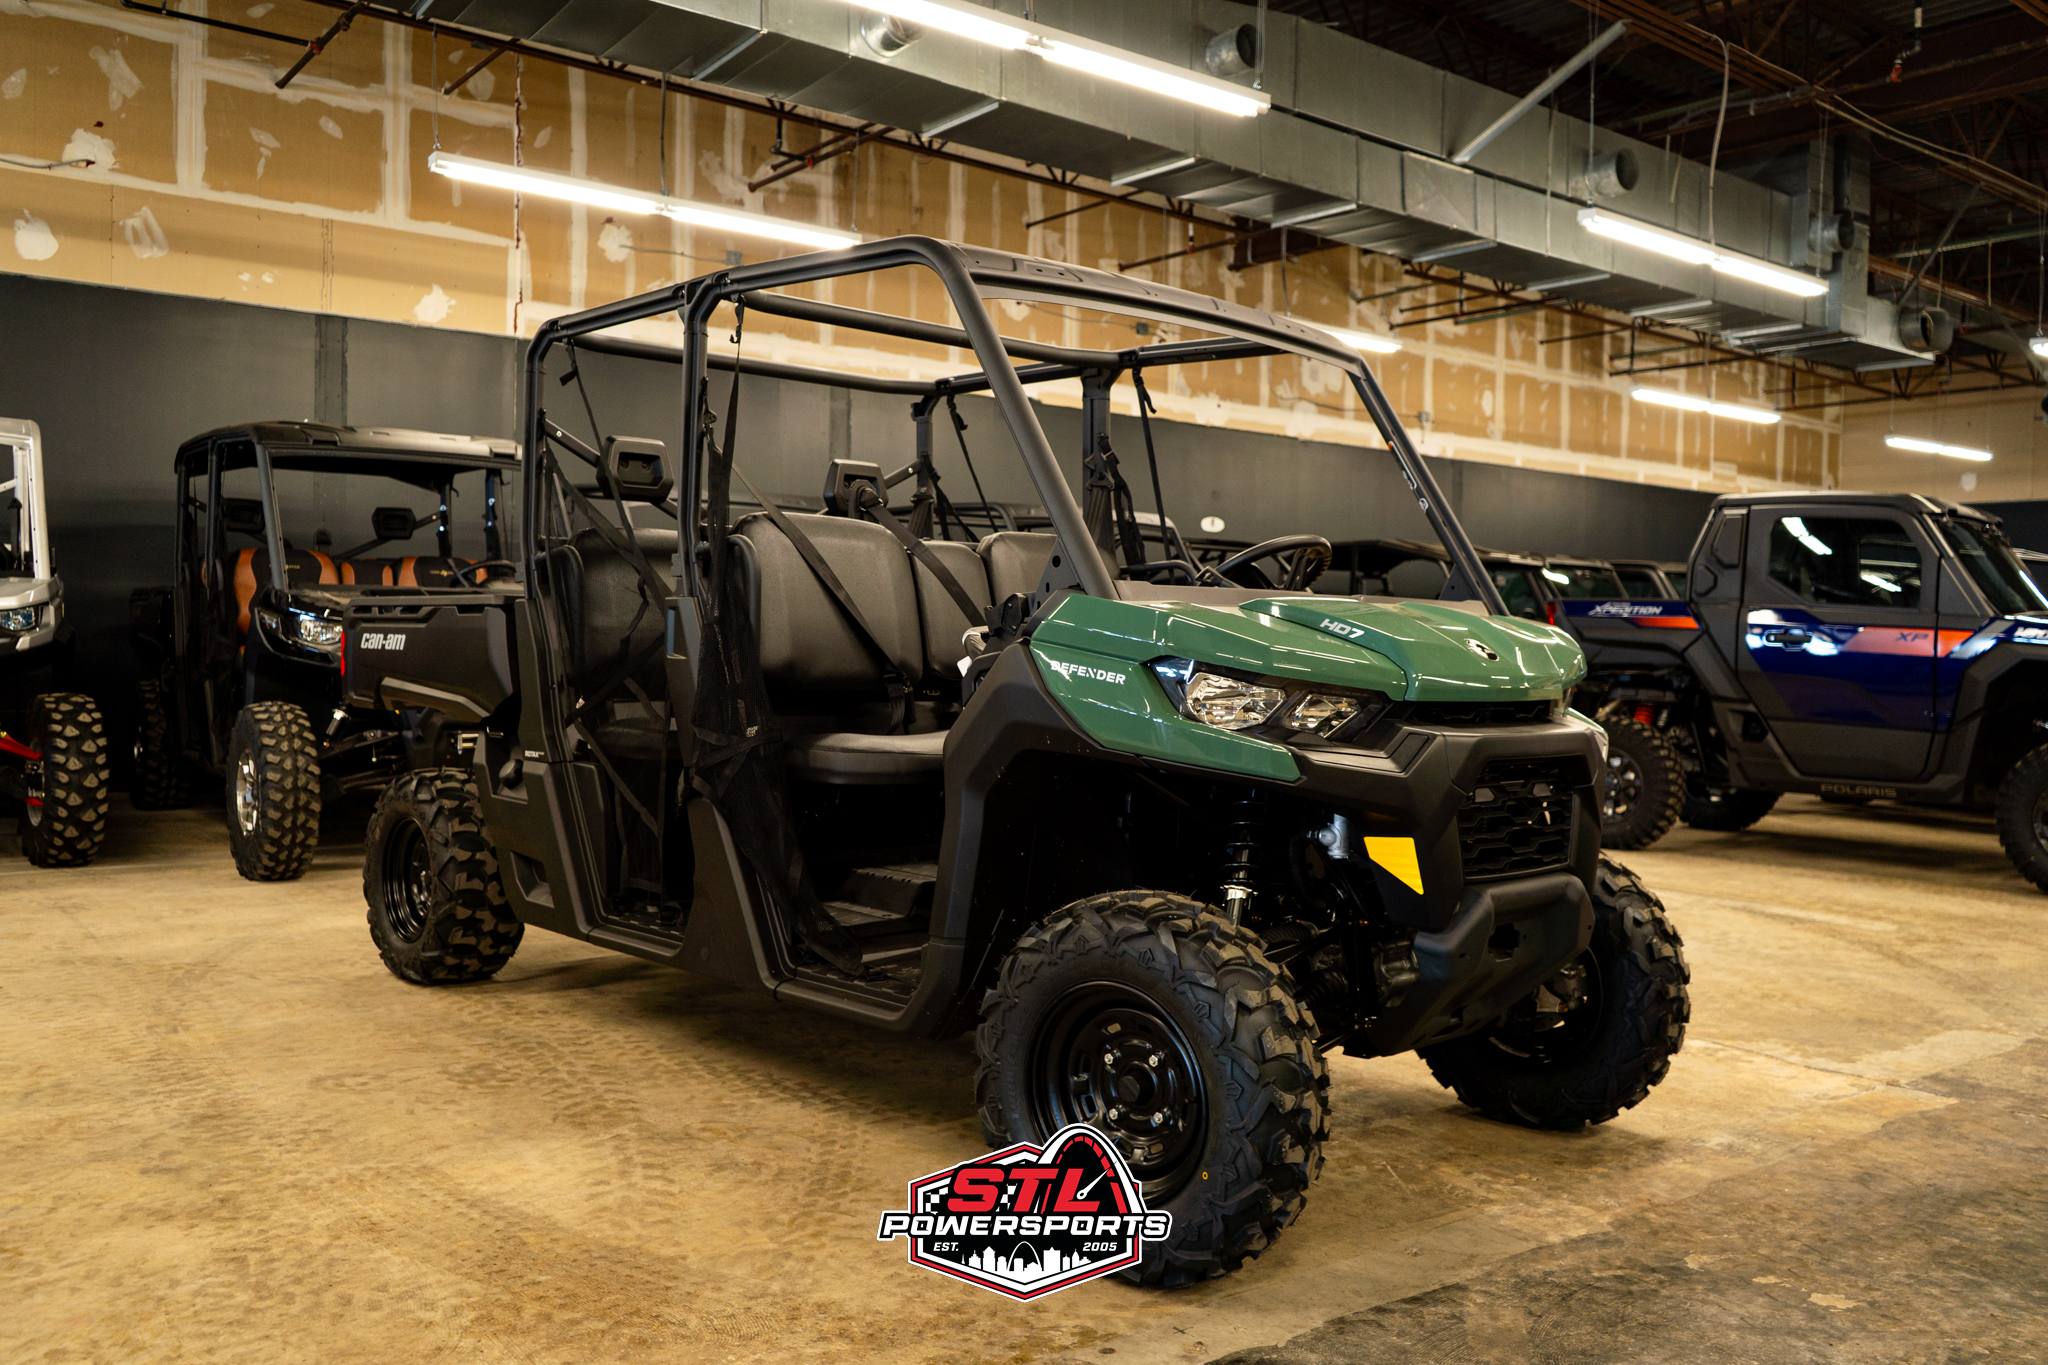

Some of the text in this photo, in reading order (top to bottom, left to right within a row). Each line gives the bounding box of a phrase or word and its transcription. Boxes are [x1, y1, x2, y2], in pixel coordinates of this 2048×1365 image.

[1320, 618, 1365, 638] HD7
[1895, 632, 1929, 642] XP
[1051, 660, 1126, 685] DEFENDER
[1821, 783, 1897, 798] POLARIS
